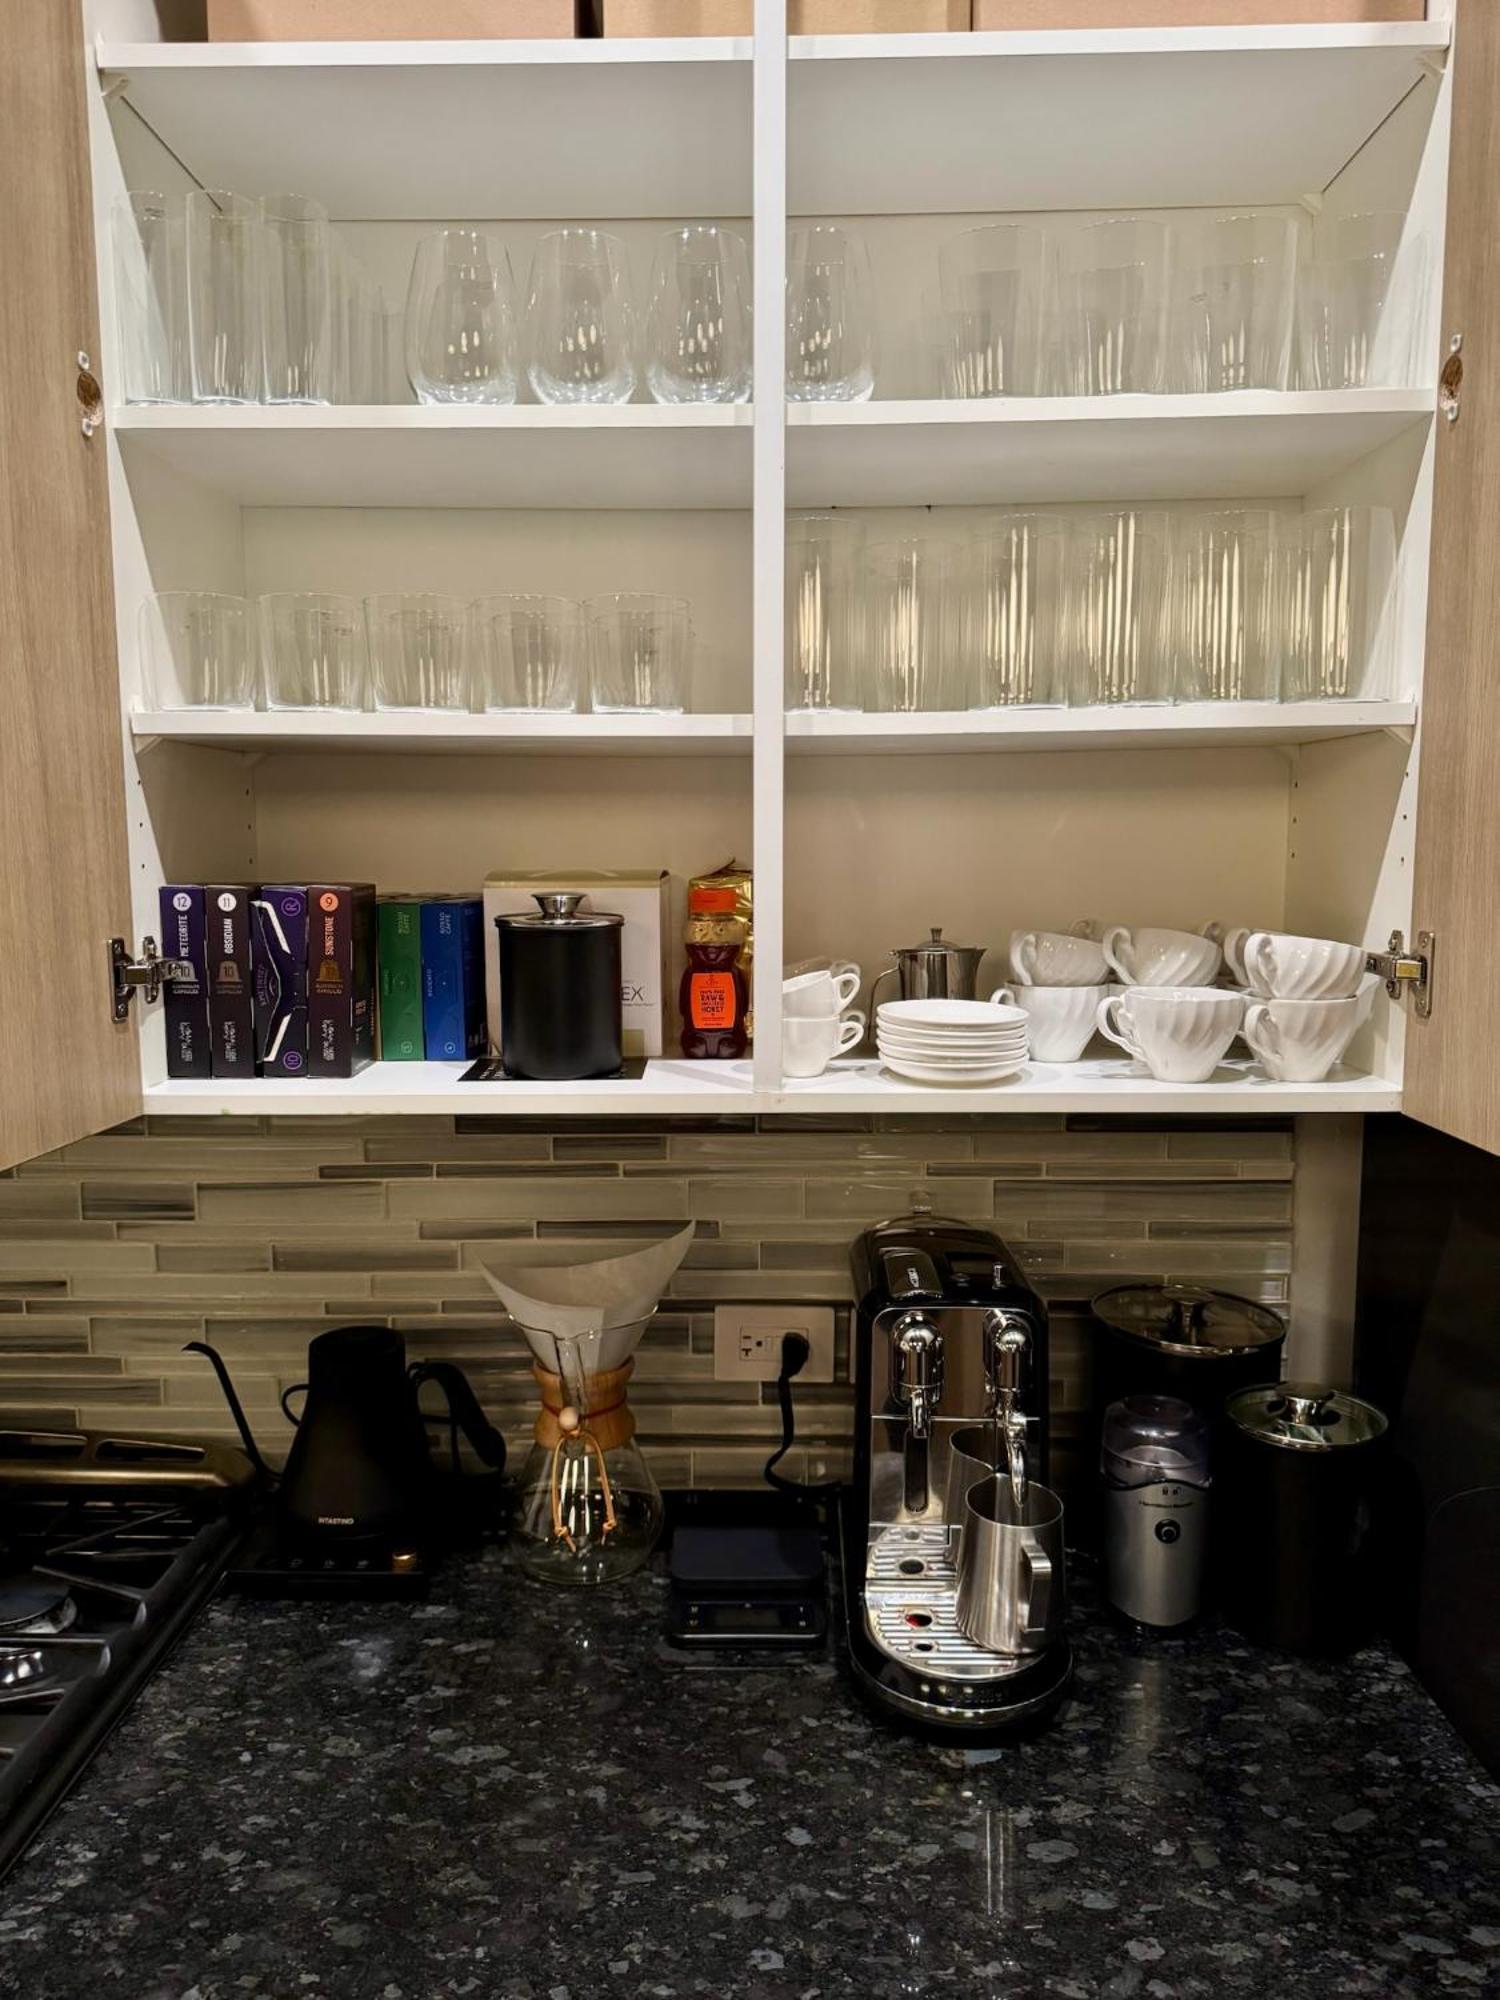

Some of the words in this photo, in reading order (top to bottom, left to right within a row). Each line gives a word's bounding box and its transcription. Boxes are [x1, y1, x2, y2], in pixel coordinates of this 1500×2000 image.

[177, 896, 189, 908] 12
[222, 896, 232, 908] 11
[178, 914, 189, 957] METEORITE
[223, 917, 234, 954] OBSIDIAN
[324, 916, 335, 956] SUNSTONE
[223, 965, 235, 977] 10
[700, 993, 718, 1001] RAW
